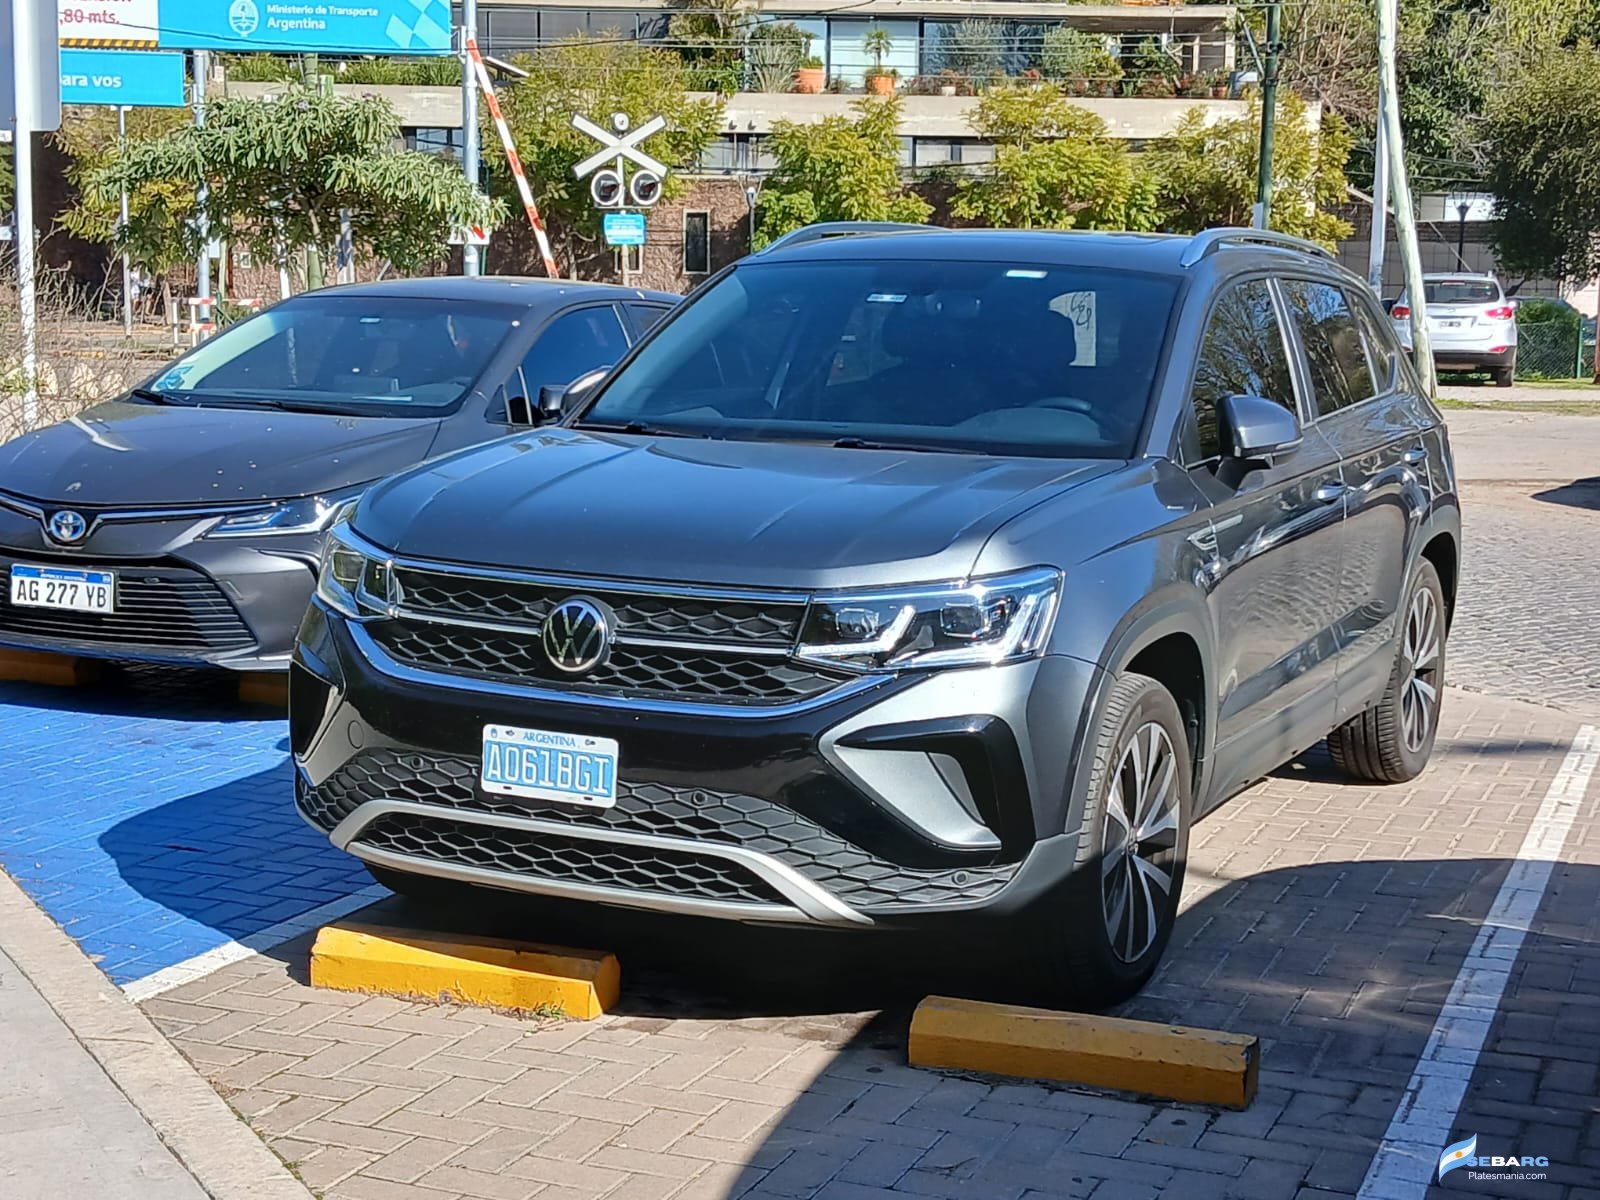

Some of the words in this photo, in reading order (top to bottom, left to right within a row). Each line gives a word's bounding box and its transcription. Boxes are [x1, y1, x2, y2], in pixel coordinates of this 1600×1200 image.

[59, 9, 84, 25] ,80
[88, 9, 120, 24] mts.
[267, 4, 313, 14] Ministerio
[315, 5, 327, 15] de
[328, 6, 379, 17] Transporte
[267, 17, 326, 31] Argentina
[61, 74, 88, 87] ara
[92, 75, 122, 88] vos
[17, 579, 39, 602] AG
[46, 581, 79, 605] 277
[86, 585, 107, 608] YB
[522, 731, 576, 747] ARGENTINA
